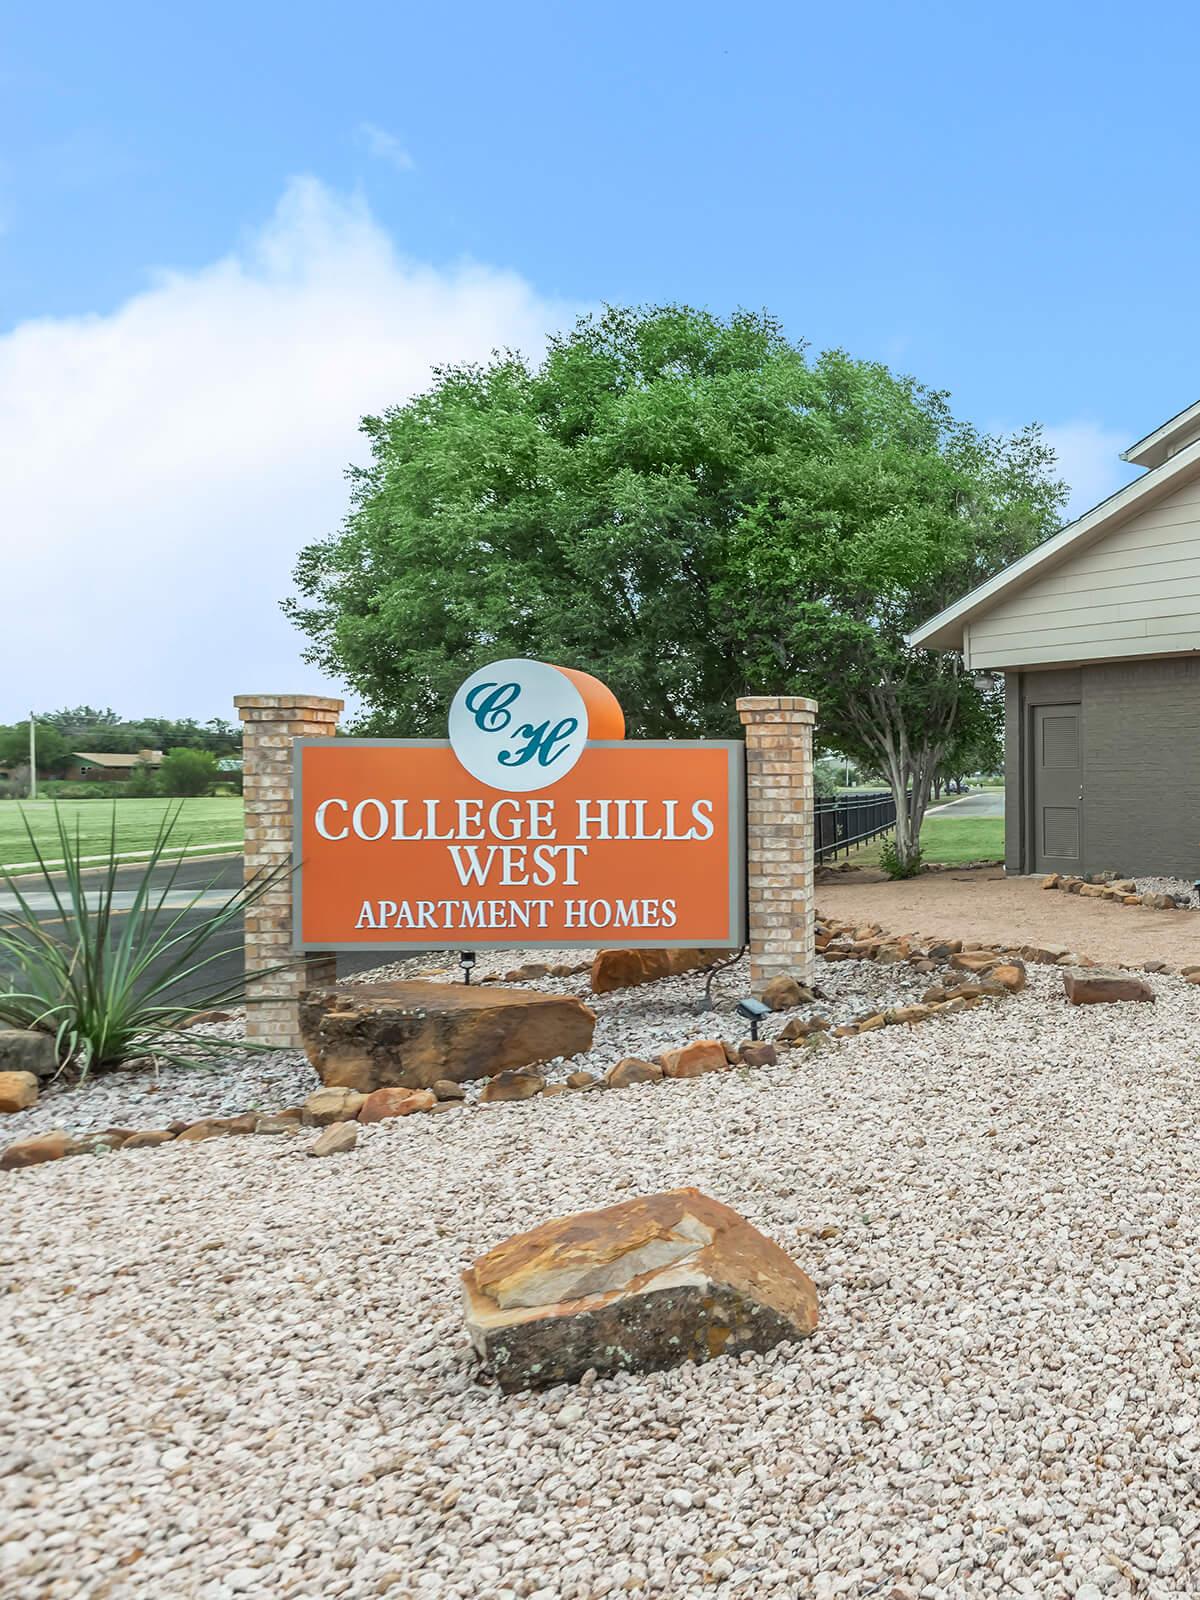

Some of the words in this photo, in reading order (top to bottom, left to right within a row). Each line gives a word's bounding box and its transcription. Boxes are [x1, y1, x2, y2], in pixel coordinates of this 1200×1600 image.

[314, 798, 558, 841] COLLEGE
[575, 799, 715, 841] HILLS
[447, 844, 589, 887] WEST
[354, 899, 555, 929] APARTMENT
[564, 898, 677, 929] HOMES
